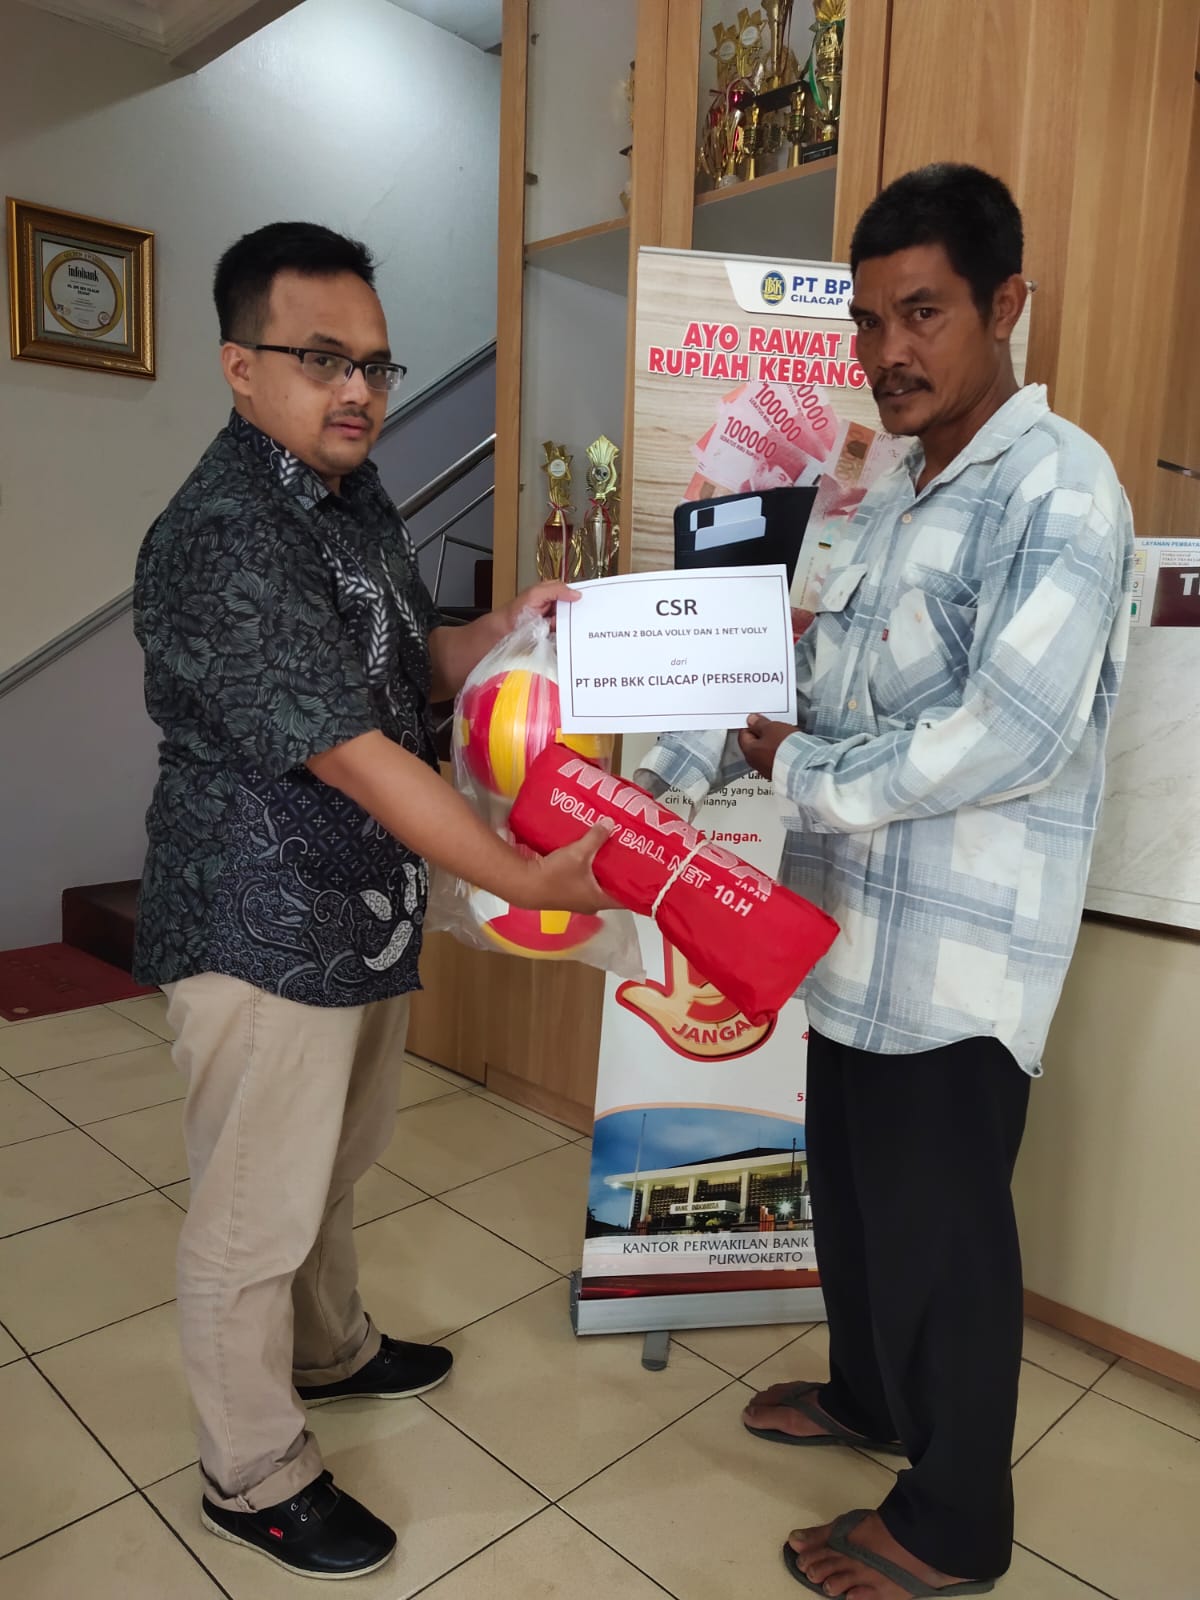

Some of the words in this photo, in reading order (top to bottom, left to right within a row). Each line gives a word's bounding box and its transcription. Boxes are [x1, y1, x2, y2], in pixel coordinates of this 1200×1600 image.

[791, 276, 819, 293] PT
[790, 294, 844, 306] CILACAP
[683, 322, 740, 352] AYO
[748, 327, 842, 359] RAWAT
[648, 347, 750, 381] RUPIAH
[758, 356, 873, 390] KEBANG
[755, 382, 802, 442] 100000
[723, 416, 777, 458] 100000
[655, 598, 699, 616] CSR
[588, 631, 631, 639] BANTUAN
[632, 630, 638, 638] 2
[640, 629, 663, 637] BOLA
[664, 628, 691, 637] VOLLY
[693, 628, 713, 636] DAN
[722, 627, 739, 635] NET
[740, 626, 768, 634] VOLLY
[670, 657, 688, 666] dari
[575, 678, 590, 688] PT
[594, 677, 618, 688] BPR
[621, 675, 645, 687] BKK
[648, 674, 699, 686] CILACAP
[702, 671, 784, 687] (PERSERODA)
[665, 796, 680, 804] ciri
[730, 787, 754, 798] yang
[557, 758, 771, 897] MIKASA
[710, 830, 762, 844] Jangan.
[619, 828, 666, 865] BALL
[713, 884, 754, 917] 10.H
[734, 879, 769, 902] JAPAN
[623, 1241, 679, 1254] KANTOR
[683, 1238, 769, 1251] PERWAKILAN
[773, 1237, 809, 1249] BANK
[709, 1252, 803, 1264] PURWOKERTO
